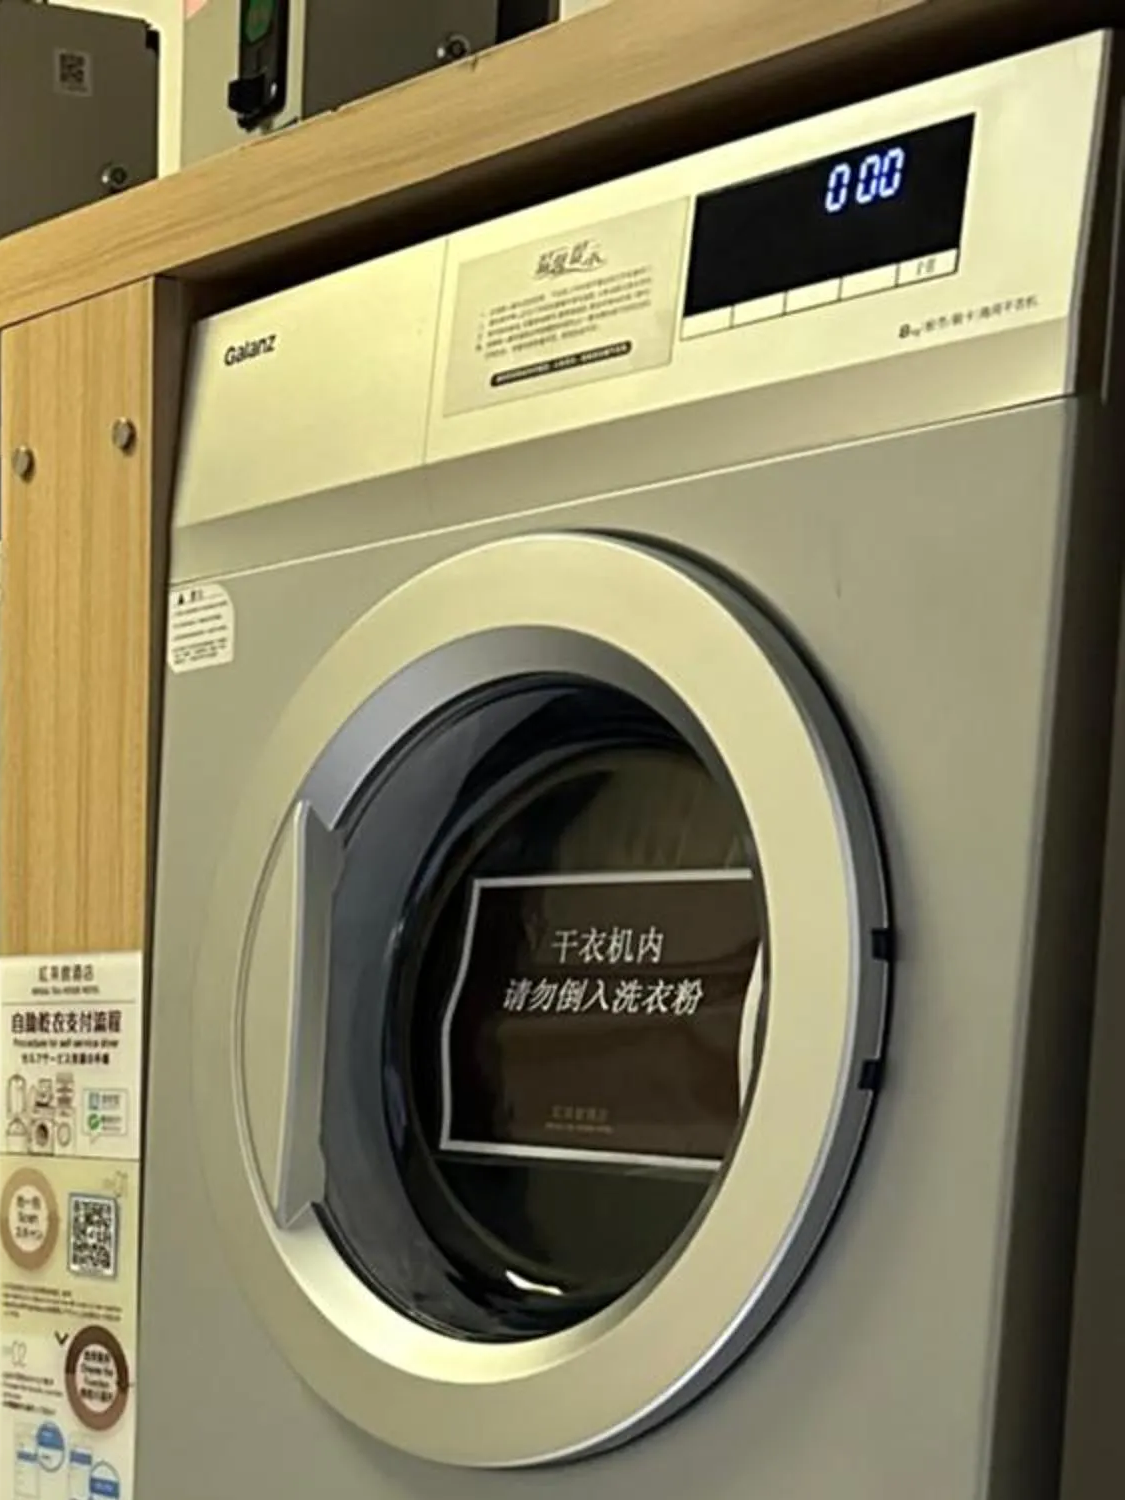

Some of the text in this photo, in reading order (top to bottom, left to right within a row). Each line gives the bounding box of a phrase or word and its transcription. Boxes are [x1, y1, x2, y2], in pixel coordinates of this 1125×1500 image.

[224, 334, 277, 367] Galanz
[551, 925, 664, 965] 干衣机内
[502, 977, 704, 1017] 请勿倒入洗衣粉
